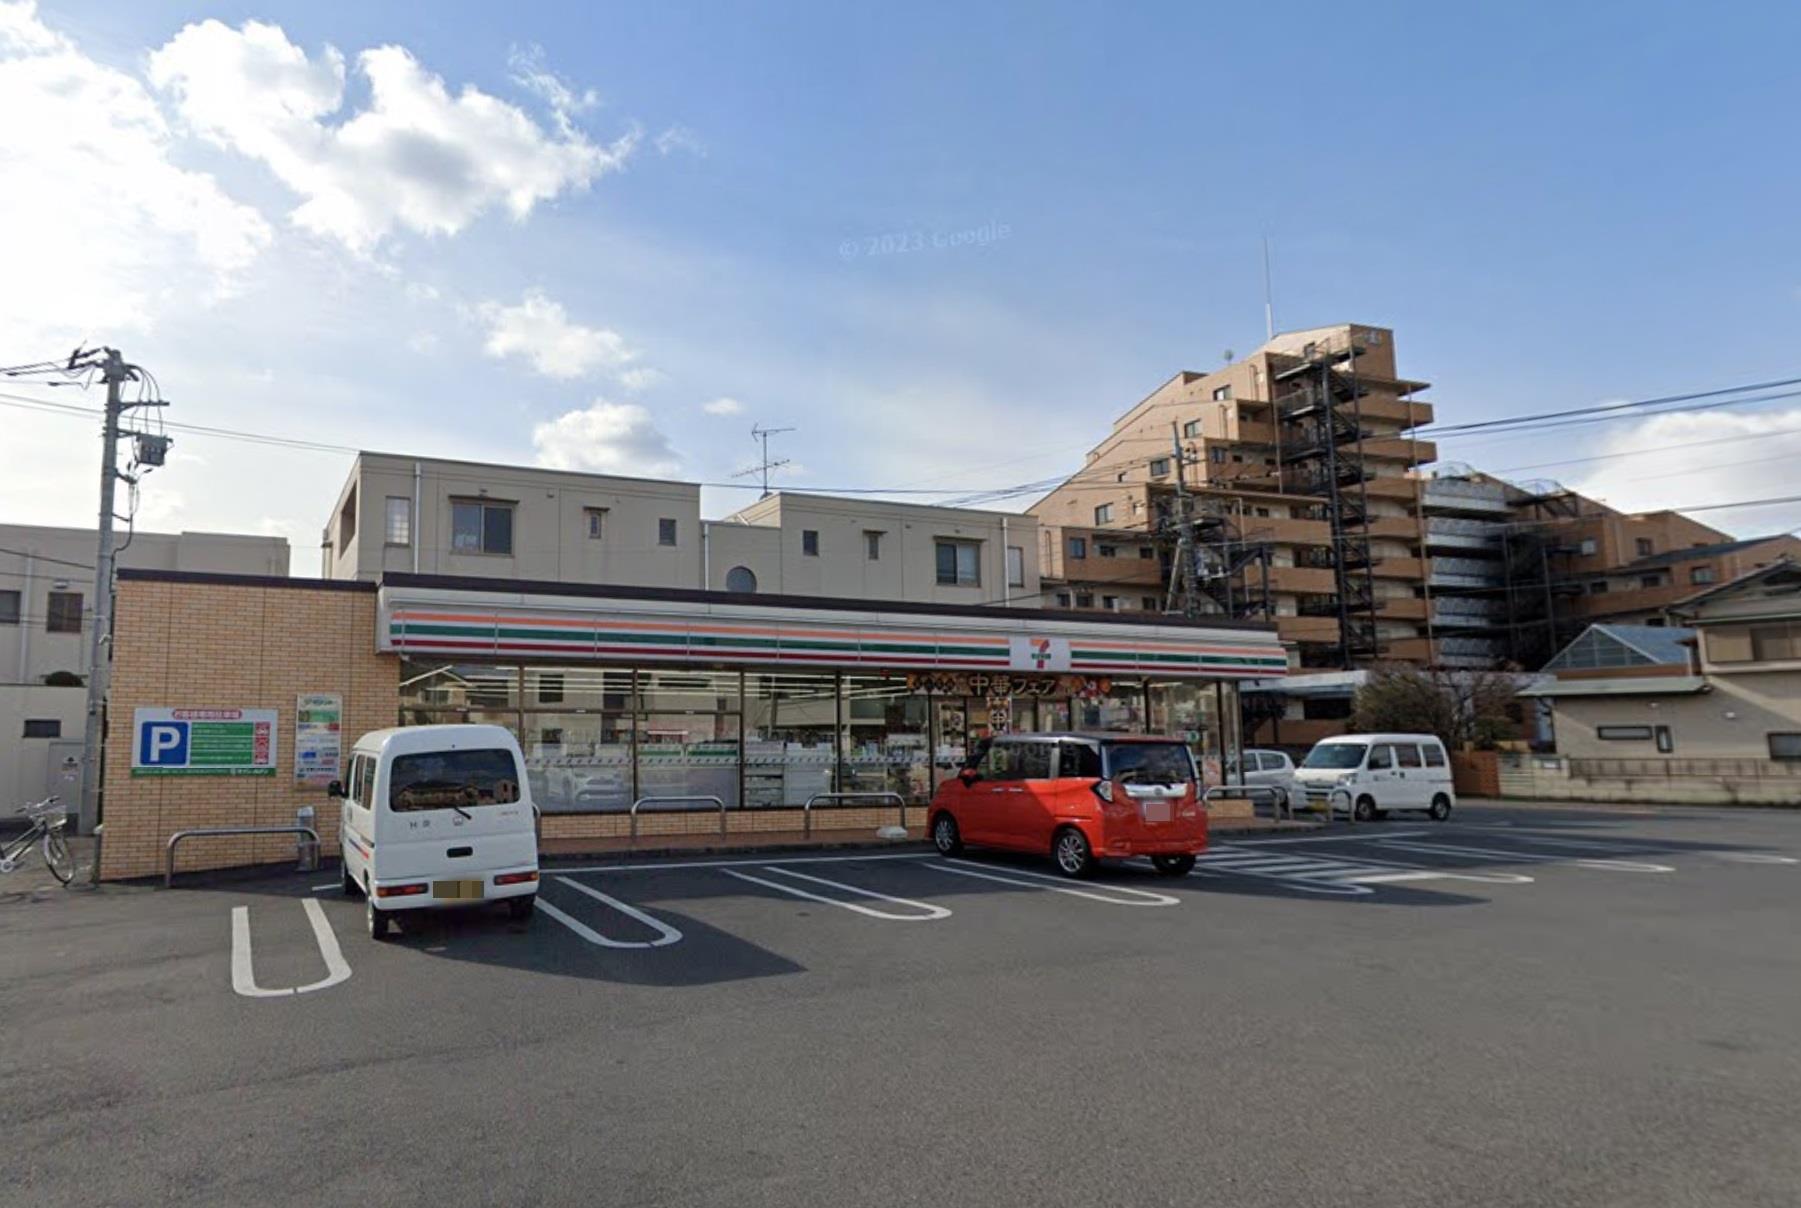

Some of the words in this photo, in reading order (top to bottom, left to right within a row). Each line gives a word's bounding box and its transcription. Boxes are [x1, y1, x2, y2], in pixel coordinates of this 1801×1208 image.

[969, 673, 1057, 697] 中華フェア
[149, 726, 181, 762] P
